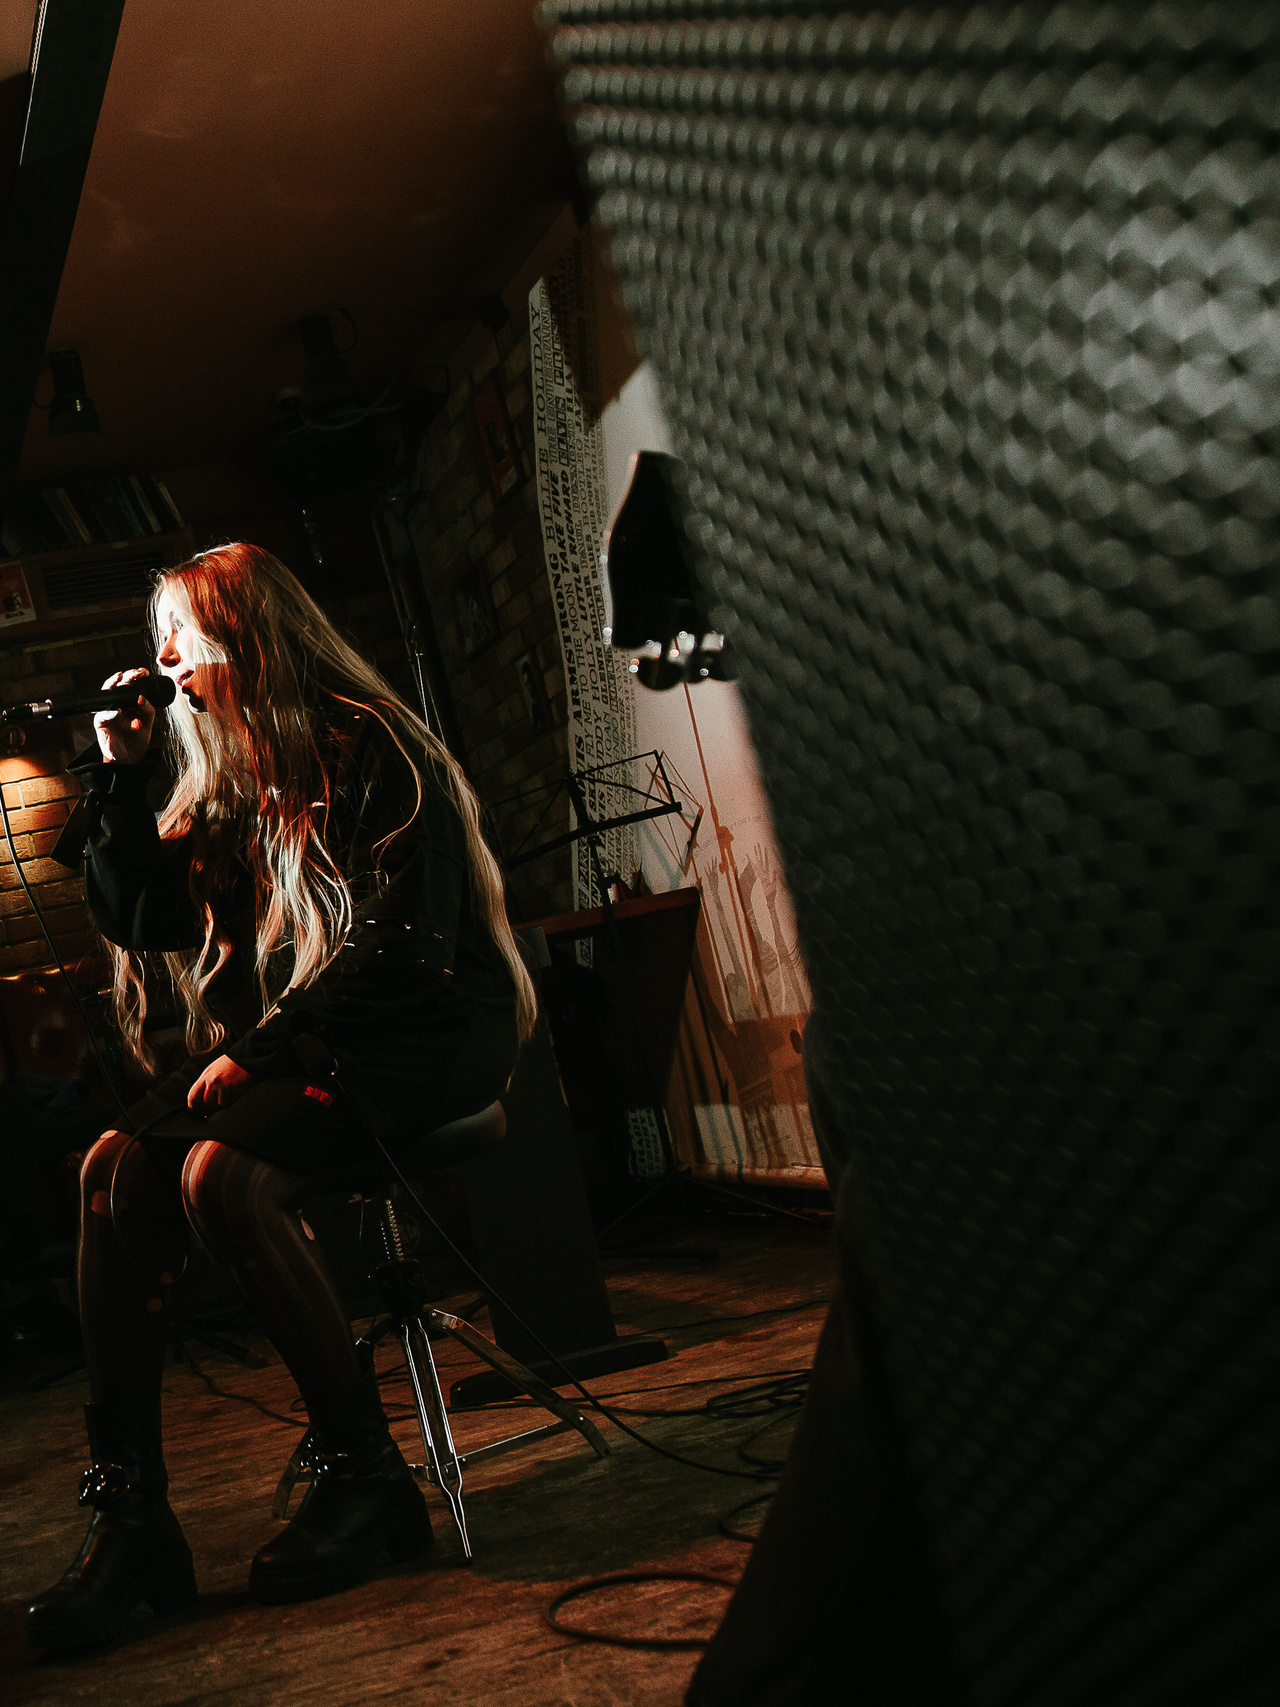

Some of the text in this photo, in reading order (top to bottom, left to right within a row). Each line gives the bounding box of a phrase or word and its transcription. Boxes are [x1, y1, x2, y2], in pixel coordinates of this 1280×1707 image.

[531, 302, 546, 435] HOLIDAY
[539, 286, 555, 421] ENTERTAINER
[555, 396, 570, 466] ELVIS
[539, 448, 556, 541] BILLIE
[550, 471, 562, 517] FIVE
[576, 438, 590, 525] BOOTLEG
[561, 470, 577, 556] RICHARD
[555, 522, 570, 574] TAKE
[585, 533, 597, 579] BLUES
[5, 611, 25, 619] Rock
[564, 583, 580, 632] MOON
[572, 563, 588, 621] LITTLE
[583, 574, 600, 642] MILLER
[549, 553, 583, 726] ARMSTRONG
[574, 638, 586, 668] THE
[583, 629, 600, 702] HOLLY
[579, 674, 589, 694] TO
[595, 647, 608, 705] GLENN
[582, 700, 592, 724] ME
[618, 697, 627, 755] CHECKER
[584, 729, 595, 758] FLY
[602, 711, 614, 806] MULIGAN
[578, 890, 591, 962] CHIE
